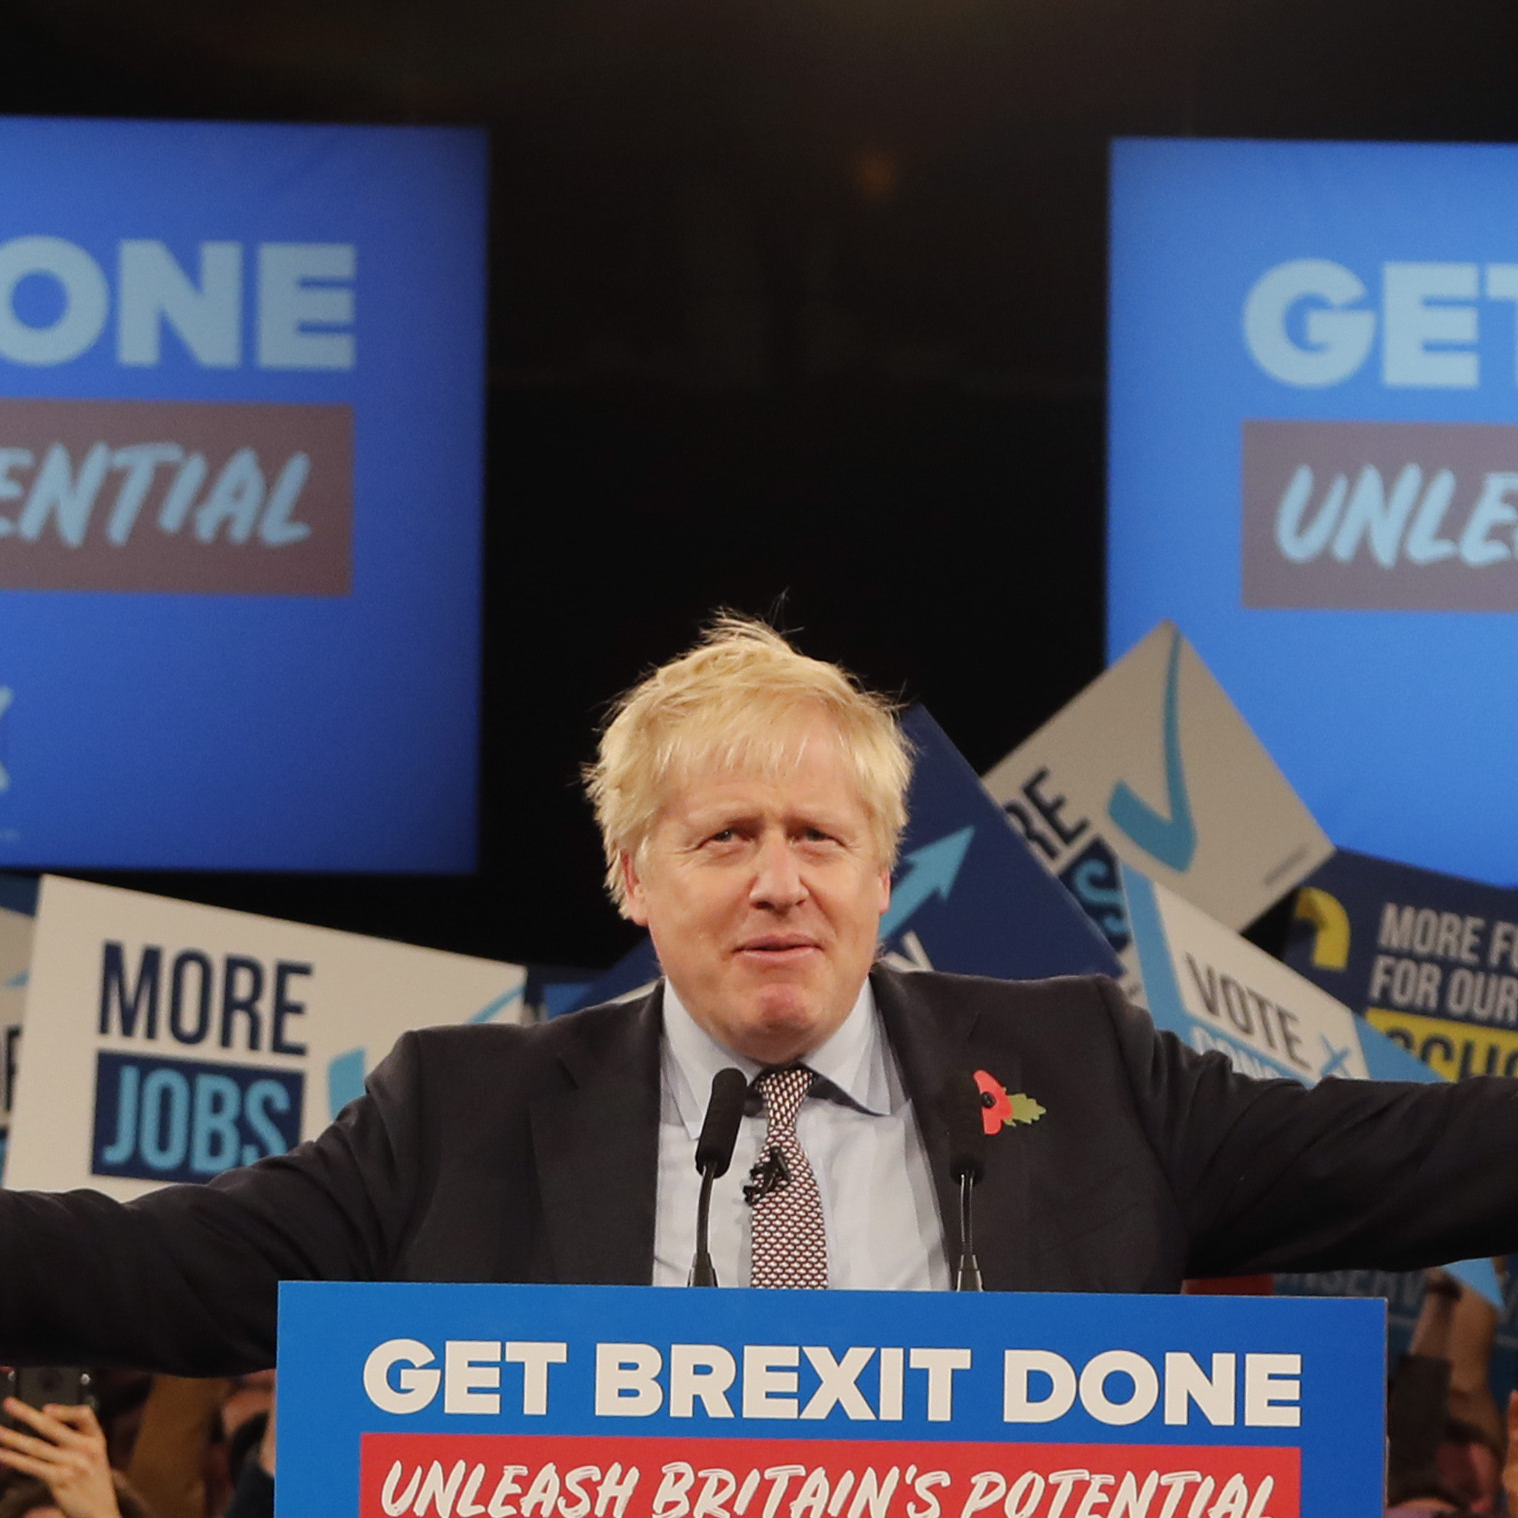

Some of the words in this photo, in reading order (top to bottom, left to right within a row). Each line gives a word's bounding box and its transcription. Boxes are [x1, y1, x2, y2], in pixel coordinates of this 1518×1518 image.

[1379, 902, 1480, 962] MORE
[97, 939, 314, 1057] MORE
[1186, 955, 1312, 1070] VOTE
[1368, 955, 1443, 1010] FOR
[101, 1065, 290, 1175] JOBS
[362, 1338, 568, 1415] GET
[595, 1342, 972, 1422] BREXIT
[1003, 1349, 1303, 1428] DONE
